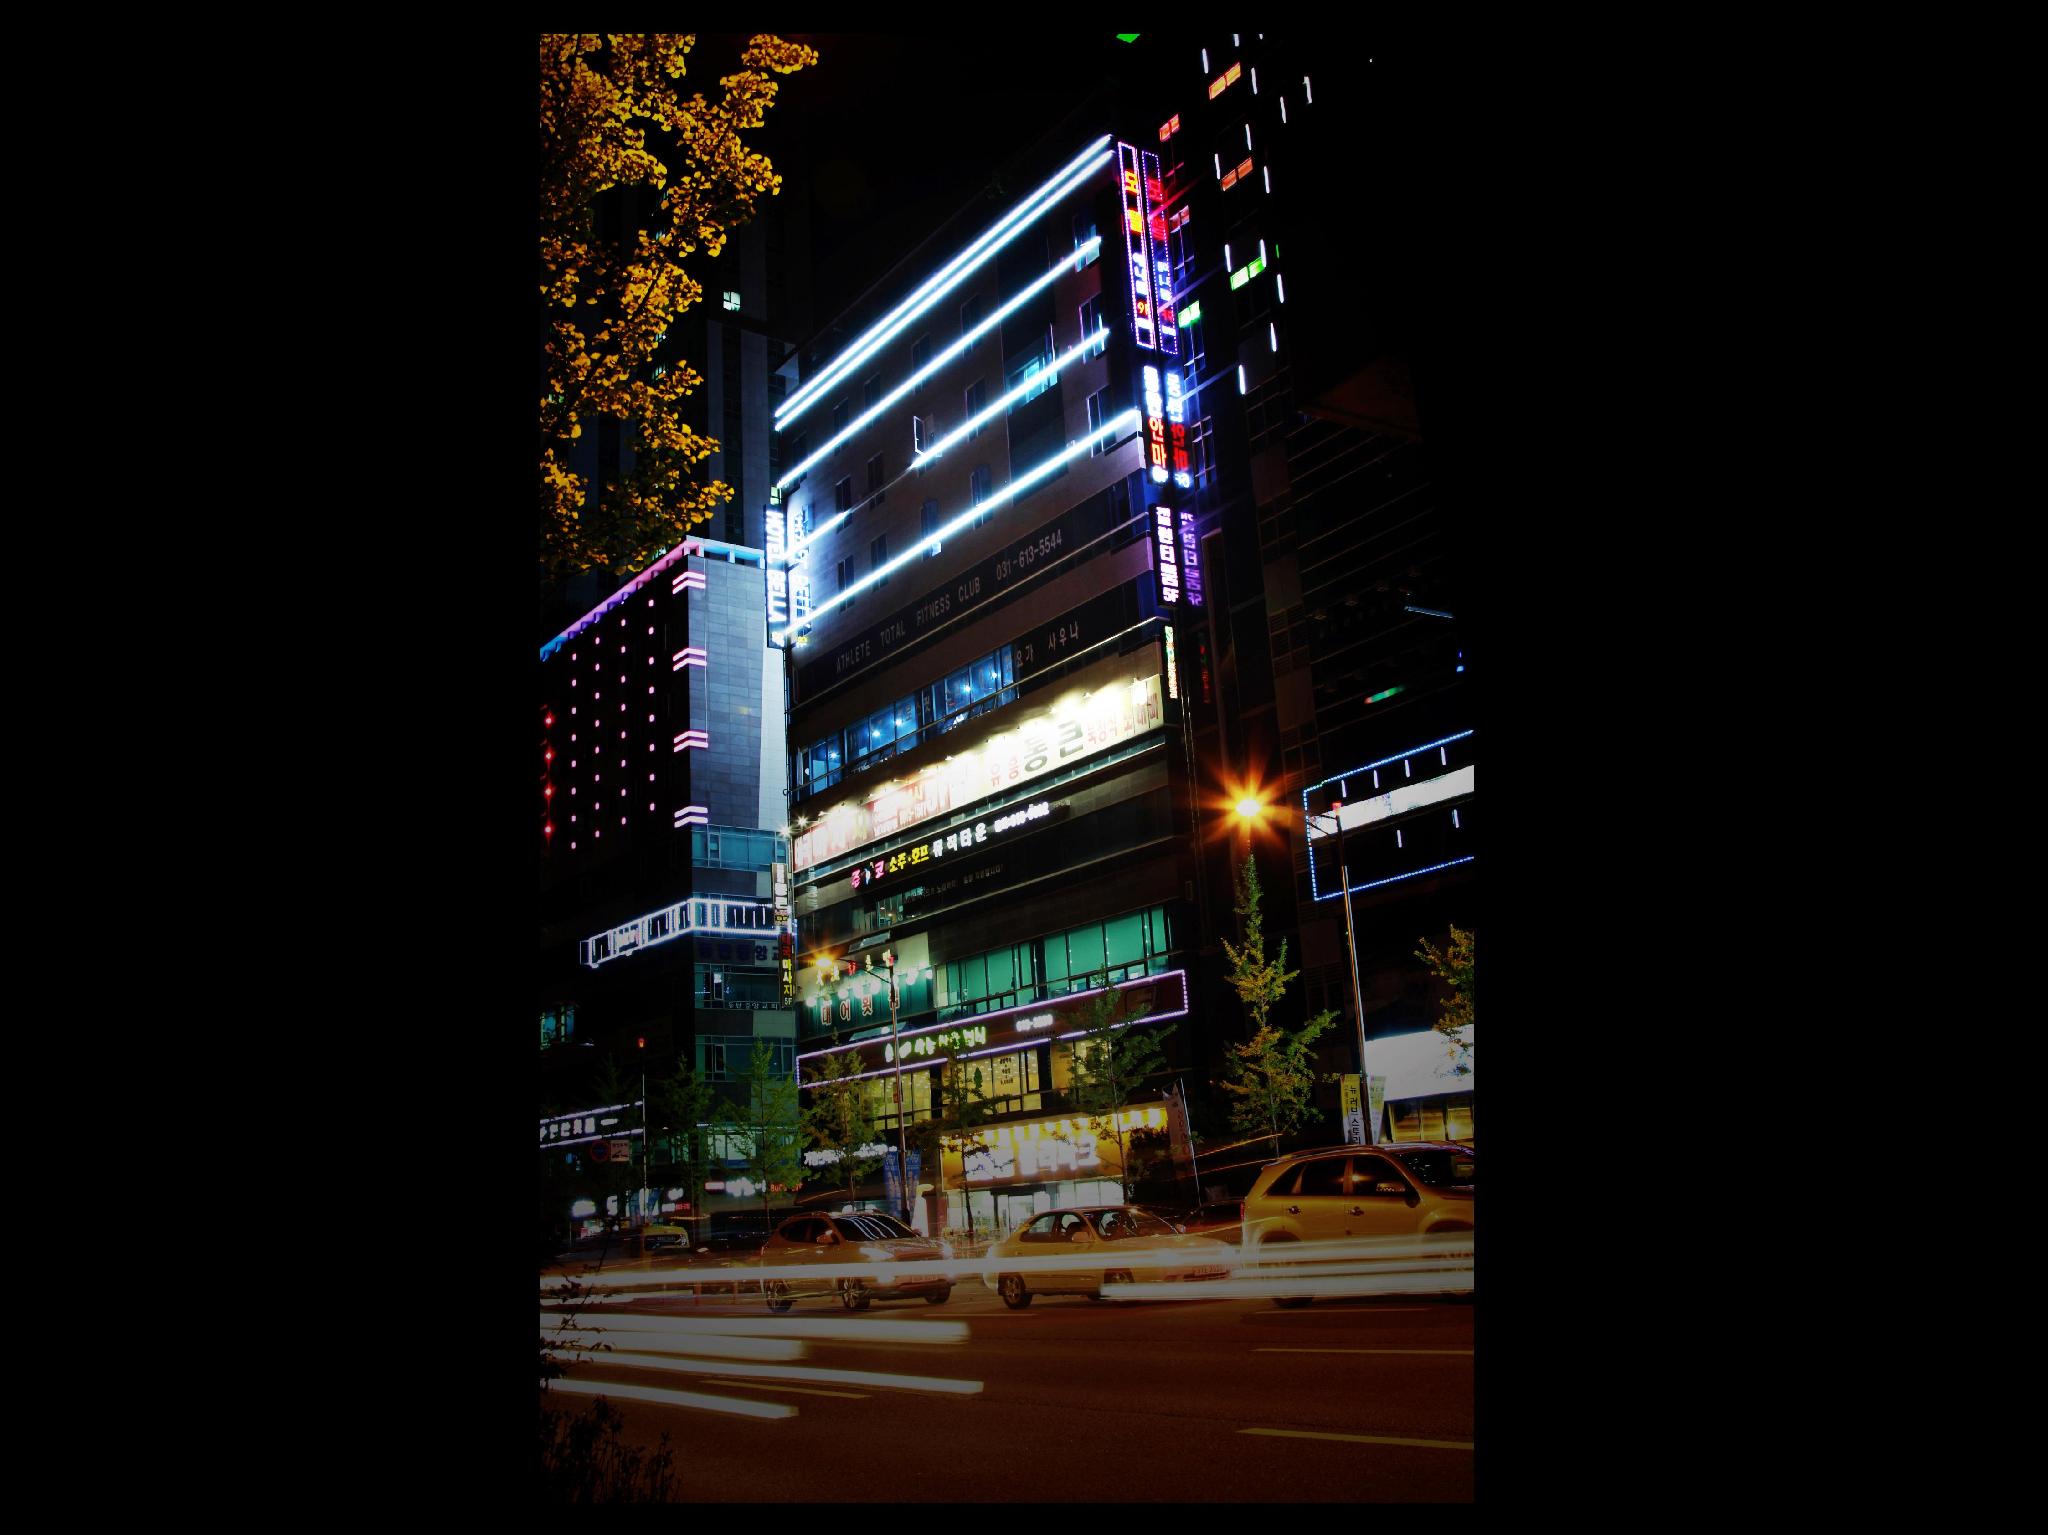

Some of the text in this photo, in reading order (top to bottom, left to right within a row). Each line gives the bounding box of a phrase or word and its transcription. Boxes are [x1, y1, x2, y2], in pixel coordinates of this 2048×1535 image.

[836, 529, 1062, 673] ATHLETE TOTAL FITNESS CLUB 031-613-5544
[1163, 587, 1179, 603] 5F
[1016, 620, 1079, 669] 요가 사우나
[782, 959, 793, 997] 마사지
